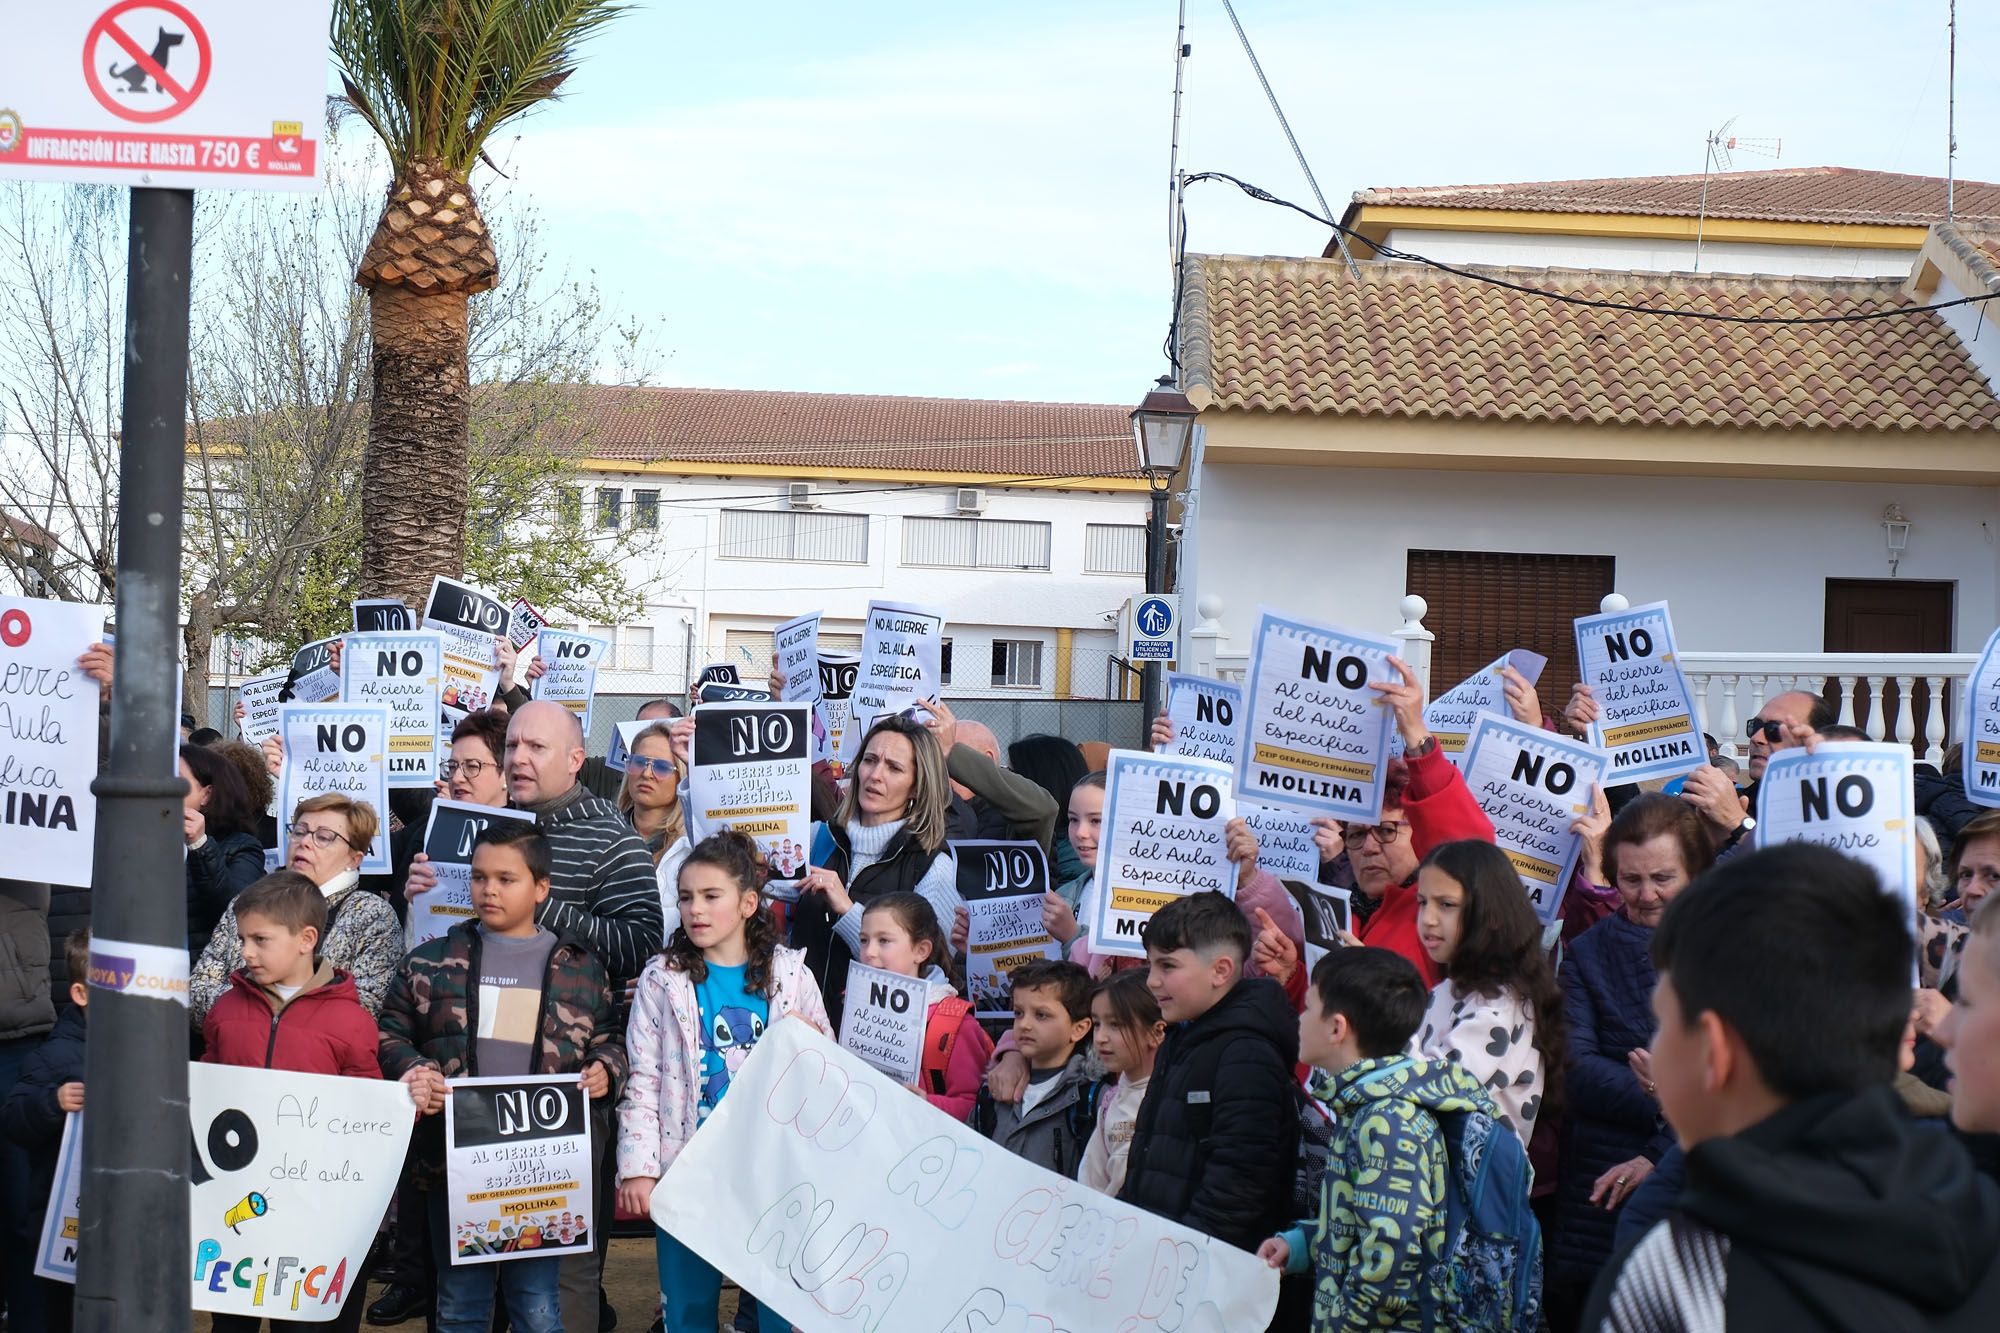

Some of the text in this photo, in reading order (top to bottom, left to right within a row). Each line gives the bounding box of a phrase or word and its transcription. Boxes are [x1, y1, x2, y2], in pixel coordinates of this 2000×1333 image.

[27, 136, 261, 169] INFRACCIÓN LEVE HASTA 750 €
[374, 608, 405, 631] NO
[458, 595, 502, 630] NO
[520, 611, 538, 629] NO
[449, 626, 483, 642] CIERRE
[794, 626, 812, 644] CIERRE
[875, 618, 929, 635] NO AL CIERRE
[557, 641, 590, 659] NO
[879, 642, 915, 656] DEL AULA
[1604, 628, 1654, 663] NO
[377, 650, 424, 677] NO
[796, 648, 808, 664] AULA
[444, 665, 476, 680] MOLLINA
[548, 661, 586, 672] Al cierre
[707, 668, 732, 685] NO
[871, 662, 921, 680] ESPECÍFICA
[1301, 645, 1368, 690] NO
[1599, 664, 1663, 685] Al cierre
[361, 681, 424, 695] Al cierre
[548, 673, 584, 684] del Aula
[819, 665, 860, 694] NO
[243, 680, 285, 698] NO AL CIERRE
[543, 686, 586, 698] Específica
[724, 690, 771, 702] NO
[885, 685, 914, 693] FERNÁNDEZ
[1274, 683, 1366, 715] Al cierre
[1457, 690, 1492, 706] Aula
[1605, 679, 1669, 702] del Aula
[251, 696, 280, 708] DEL AUL
[859, 696, 886, 708] MOLLINA
[1196, 693, 1234, 727] NO
[1606, 699, 1680, 722] Específica
[1273, 701, 1363, 735] del Aula
[1430, 710, 1478, 729] Específi
[253, 727, 276, 737] MOLLINA
[317, 723, 367, 753] NO
[731, 712, 794, 756] NO
[1179, 725, 1235, 747] Al cierre
[1264, 722, 1369, 756] Específica
[1607, 720, 1689, 741] CEIP GERARDO FERNÁNDEZ
[1178, 742, 1235, 764] del Aula
[1614, 739, 1693, 768] MOLLINA
[1980, 748, 1996, 756] CEIP
[303, 757, 368, 774] Al cierre
[389, 758, 426, 772] LINA
[709, 763, 801, 782] AL CIERRE DEL
[1259, 750, 1371, 777] CEIP GERARDO FERNÁNDEZ
[1510, 748, 1577, 796] NO
[303, 776, 368, 791] del Aula
[738, 779, 771, 792] AULA
[1259, 770, 1363, 804] MOLLINA
[720, 790, 793, 806] ESPECÍFICA
[1156, 779, 1221, 820] NO
[1483, 781, 1567, 819] Al cierre
[1800, 773, 1874, 823] NO
[723, 807, 754, 816] GERARDO
[755, 804, 795, 813] FERNÁNDEZ
[1479, 797, 1560, 835] del Aula
[736, 823, 780, 833] MOLLINA
[1130, 820, 1220, 844] Al cierre
[1245, 814, 1310, 834] Al cierre
[1129, 841, 1217, 866] del Aula
[1273, 836, 1310, 853] Aula
[436, 866, 449, 878] AL
[984, 848, 1034, 892] NO
[1121, 864, 1223, 890] Específica
[1512, 858, 1558, 878] FERNÁNDEZ
[981, 900, 1019, 916] CIERRE
[991, 913, 1022, 928] AULA
[977, 921, 1045, 942] ESPECÍFICA
[982, 936, 1048, 952] GERARDO FERNÁNDEZ
[121, 972, 132, 987] Y
[480, 976, 519, 985] COOL TODAY
[869, 981, 910, 1014] NO
[854, 1008, 908, 1032] Al cierre
[852, 1022, 906, 1048] del Aula
[848, 1037, 909, 1065] Específica
[276, 1093, 394, 1137] Al cierre
[495, 1086, 569, 1135] NO
[768, 1049, 879, 1153] NO
[888, 1134, 985, 1232] AL
[471, 1141, 579, 1165] AL CIERRE DEL
[270, 1152, 366, 1183] del aula
[508, 1158, 546, 1174] AULA
[485, 1168, 572, 1190] ESPECÍFICA
[469, 1182, 574, 1201] CEIP GERARDO FERNÁNDEZ
[504, 1199, 559, 1213] MOLLINA
[748, 1182, 911, 1333] AULA
